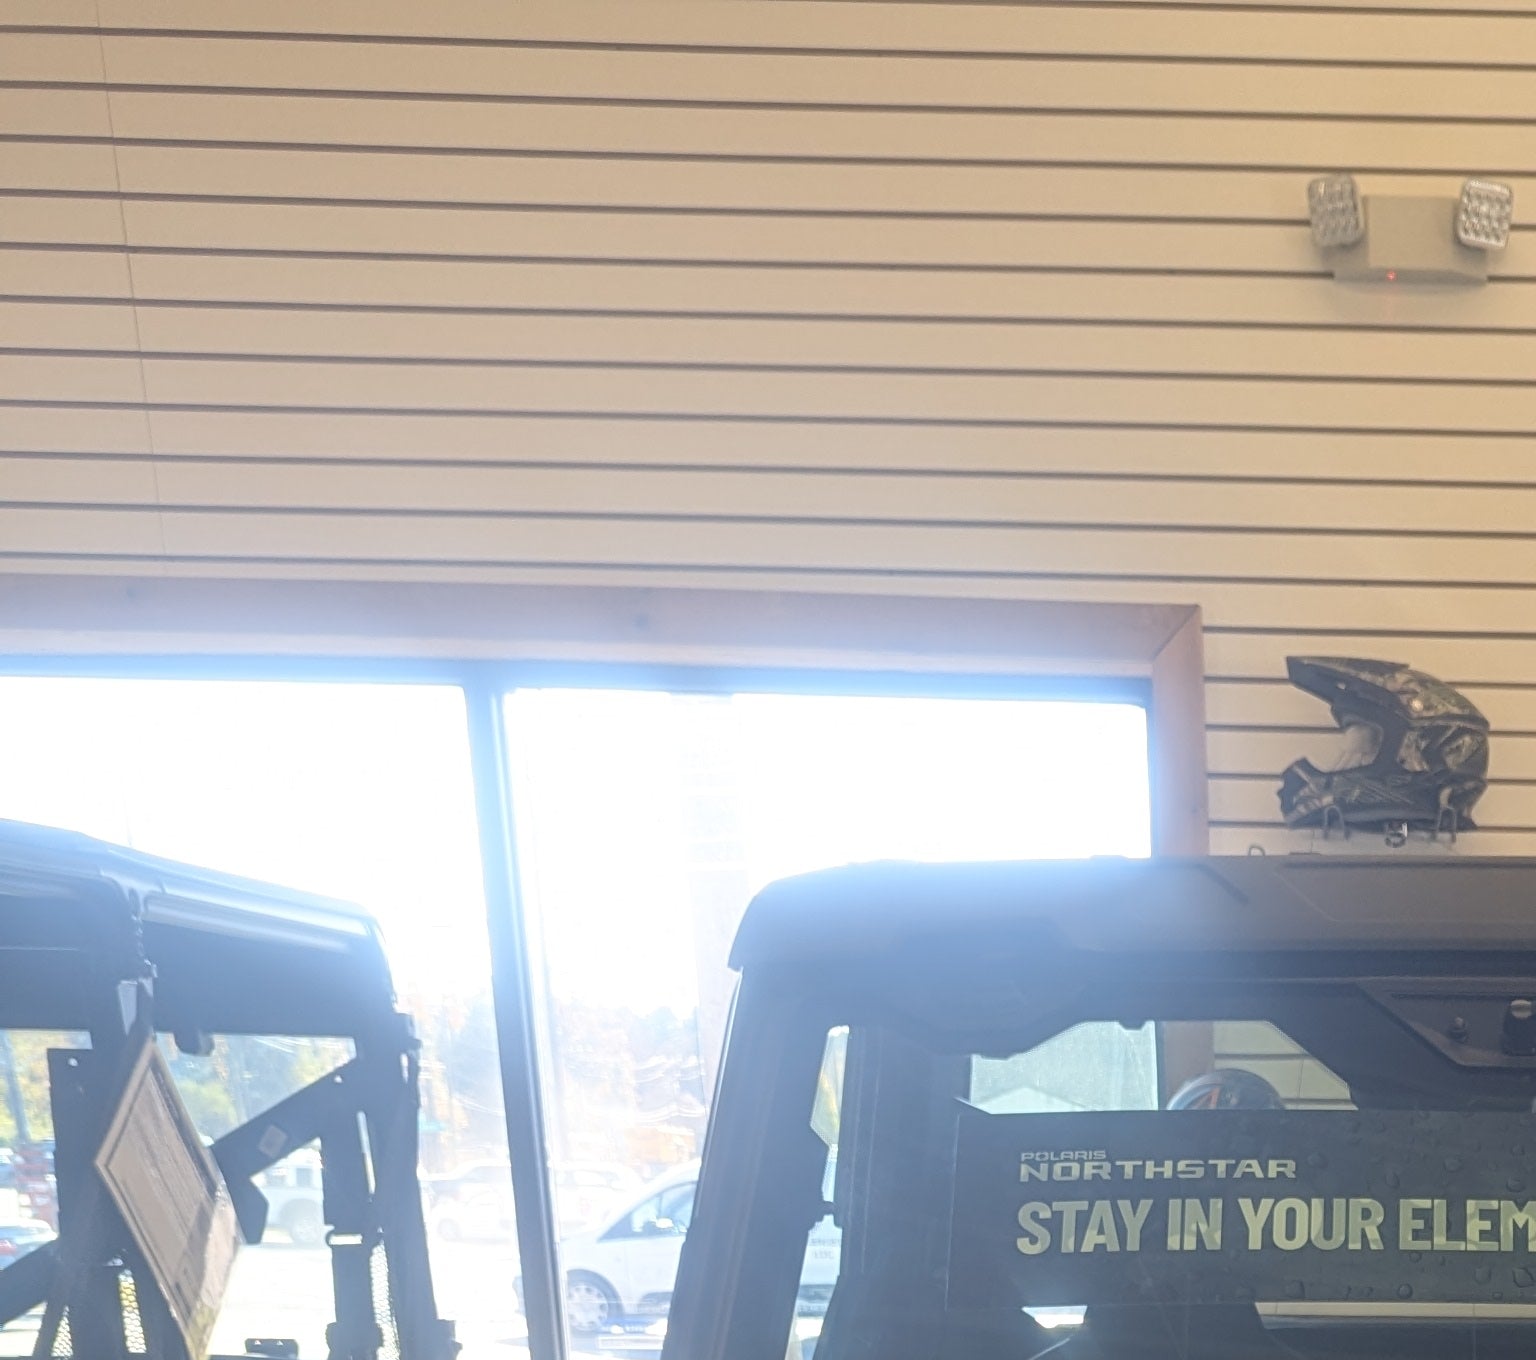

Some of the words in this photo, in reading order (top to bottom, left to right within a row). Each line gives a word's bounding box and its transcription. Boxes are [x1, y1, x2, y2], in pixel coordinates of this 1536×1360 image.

[1020, 1150, 1106, 1161] POLARIS
[1019, 1159, 1297, 1182] NORTHSTAR
[1016, 1199, 1153, 1255] STAY
[1167, 1198, 1223, 1251] IN
[1238, 1198, 1385, 1251] YOUR
